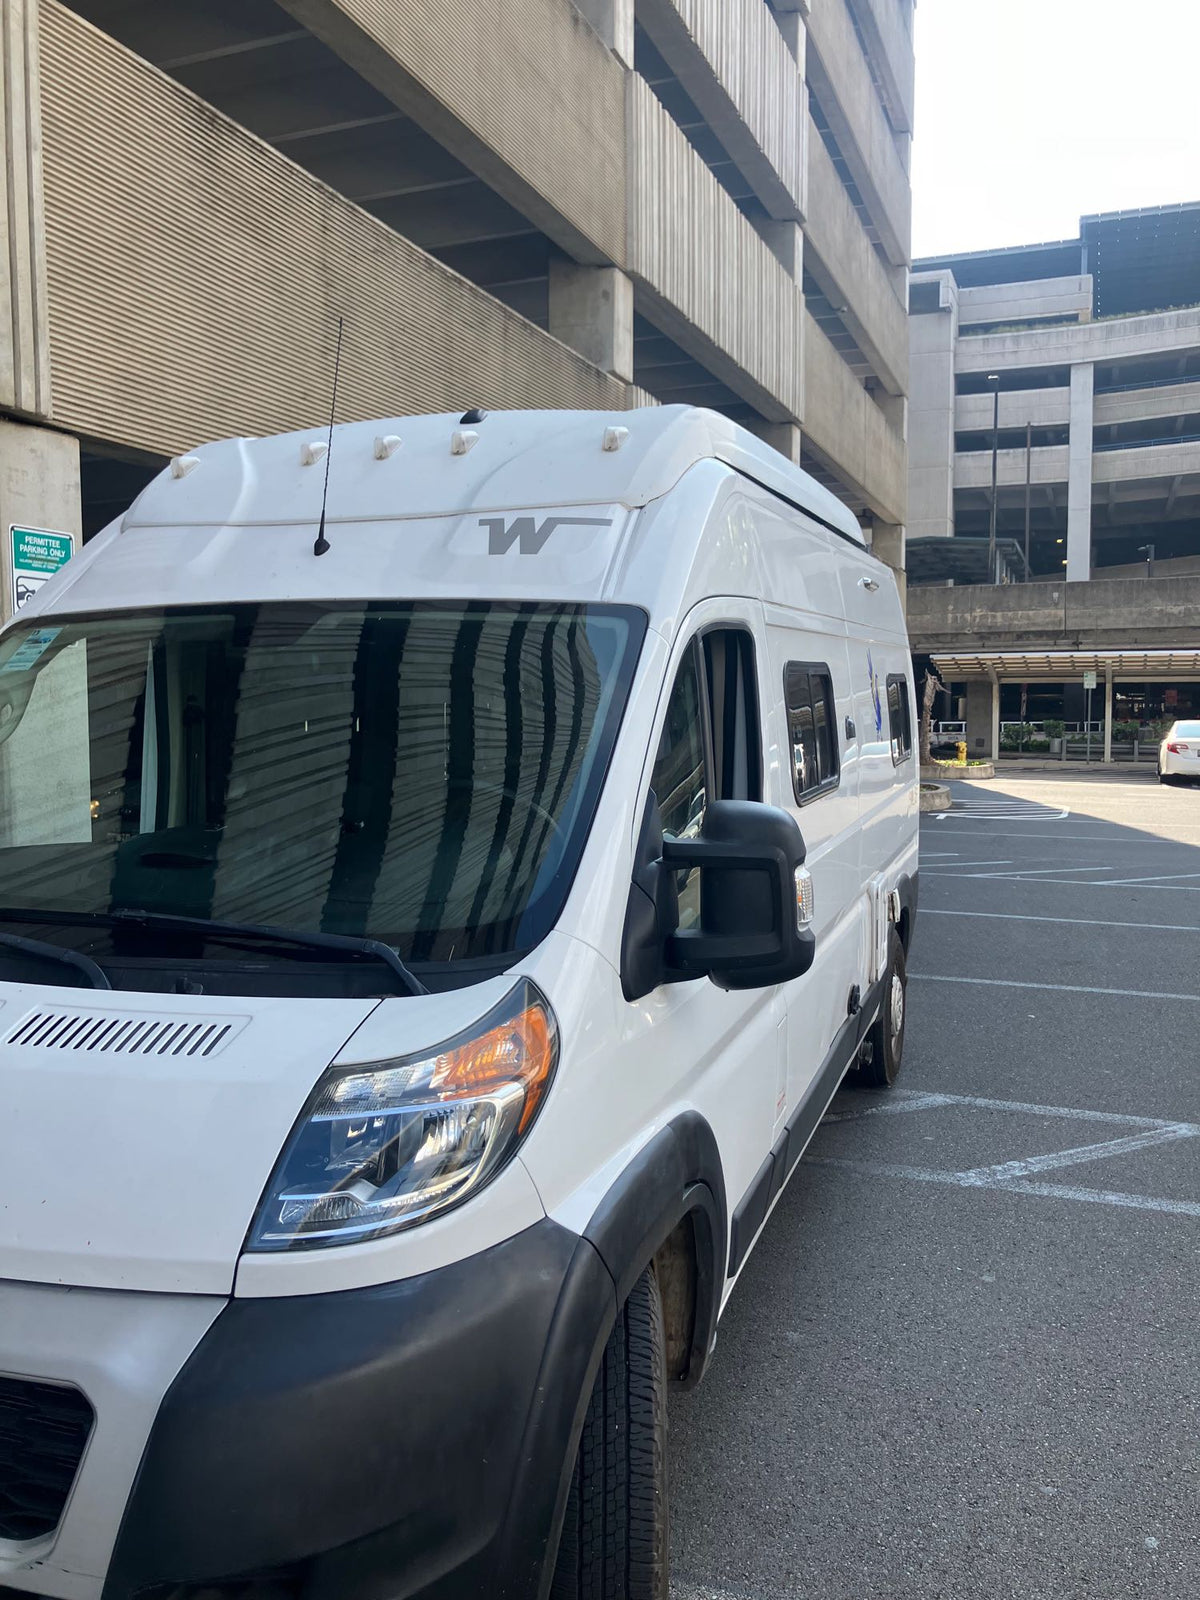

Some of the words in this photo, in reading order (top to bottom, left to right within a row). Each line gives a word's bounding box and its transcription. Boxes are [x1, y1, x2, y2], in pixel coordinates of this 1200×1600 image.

[25, 536, 60, 548] PERMITTEE
[478, 517, 613, 555] W
[19, 544, 48, 555] PARKING
[49, 548, 66, 558] ONLY
